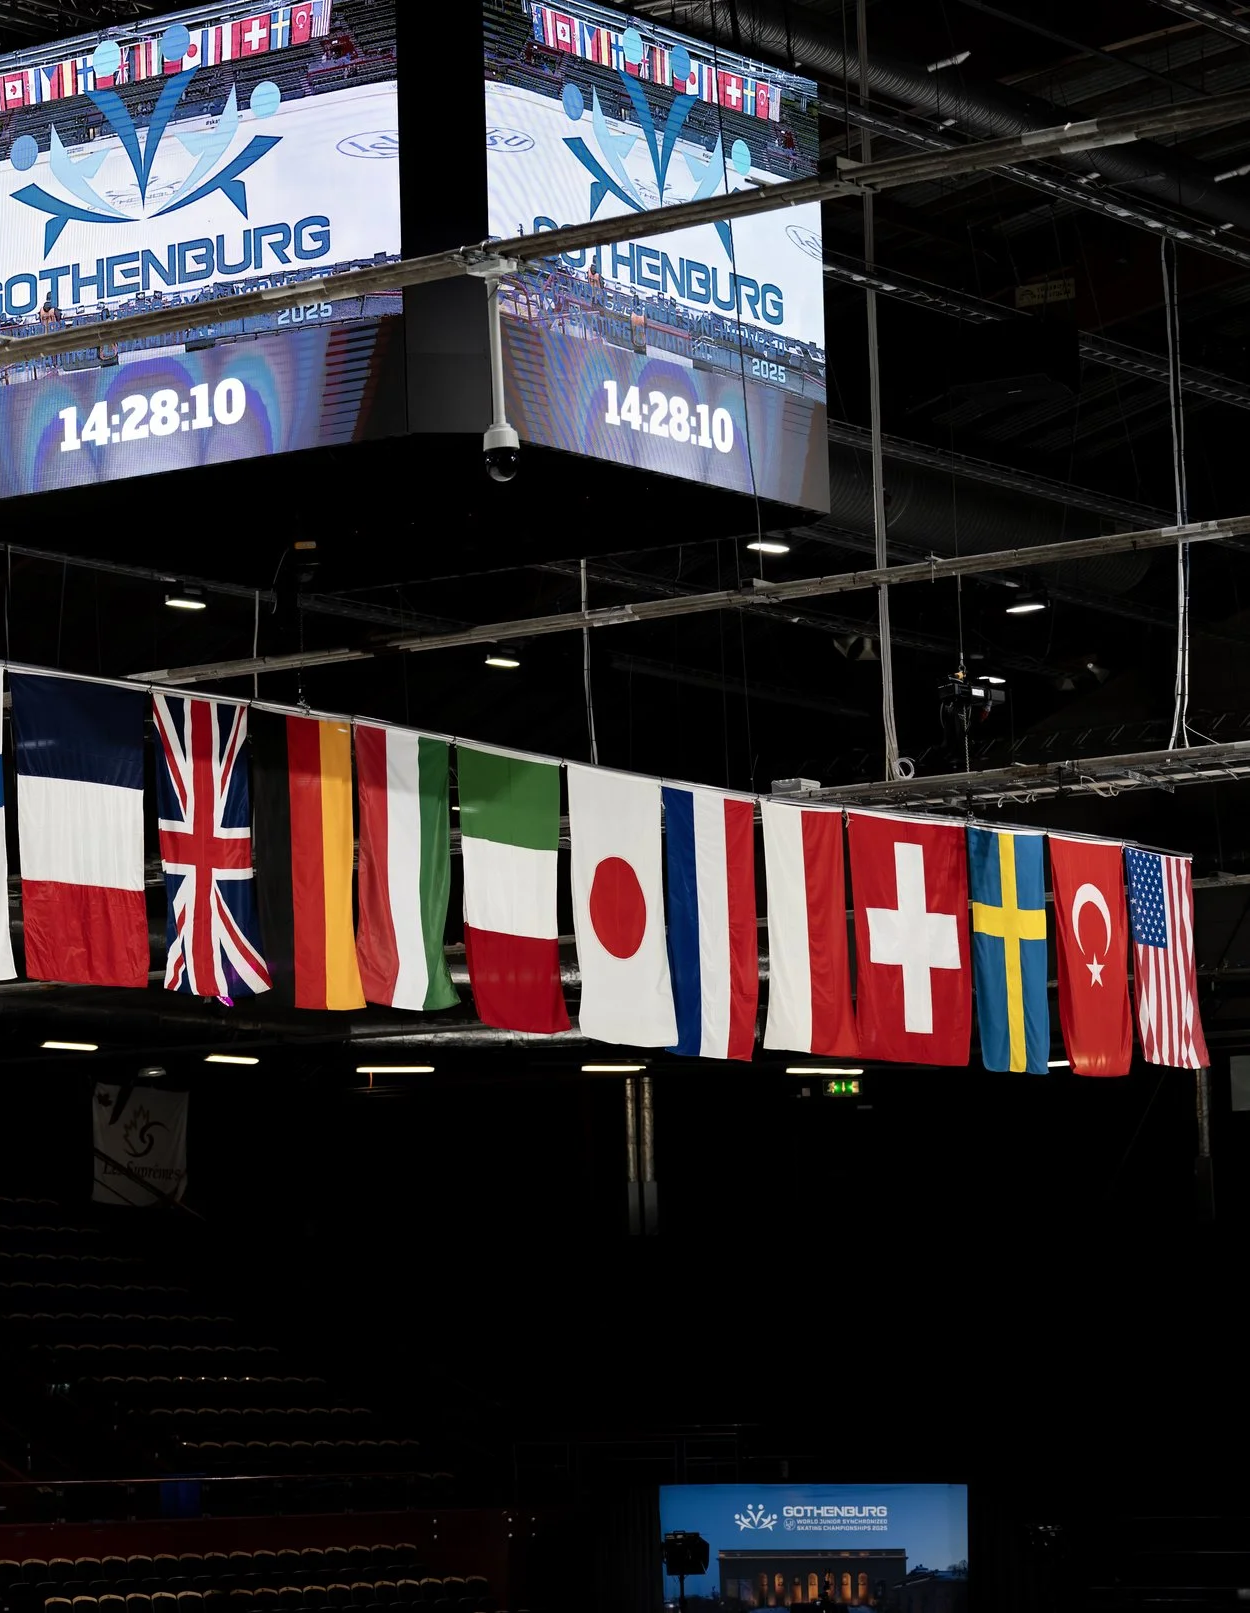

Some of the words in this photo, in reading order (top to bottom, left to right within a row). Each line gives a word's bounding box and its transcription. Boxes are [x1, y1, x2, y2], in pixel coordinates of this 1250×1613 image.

[277, 302, 332, 325] 2025
[752, 358, 786, 384] 2025
[59, 377, 247, 452] 14:28:10
[603, 379, 734, 453] 14:28:10
[782, 1506, 887, 1517] GOTHENBURG
